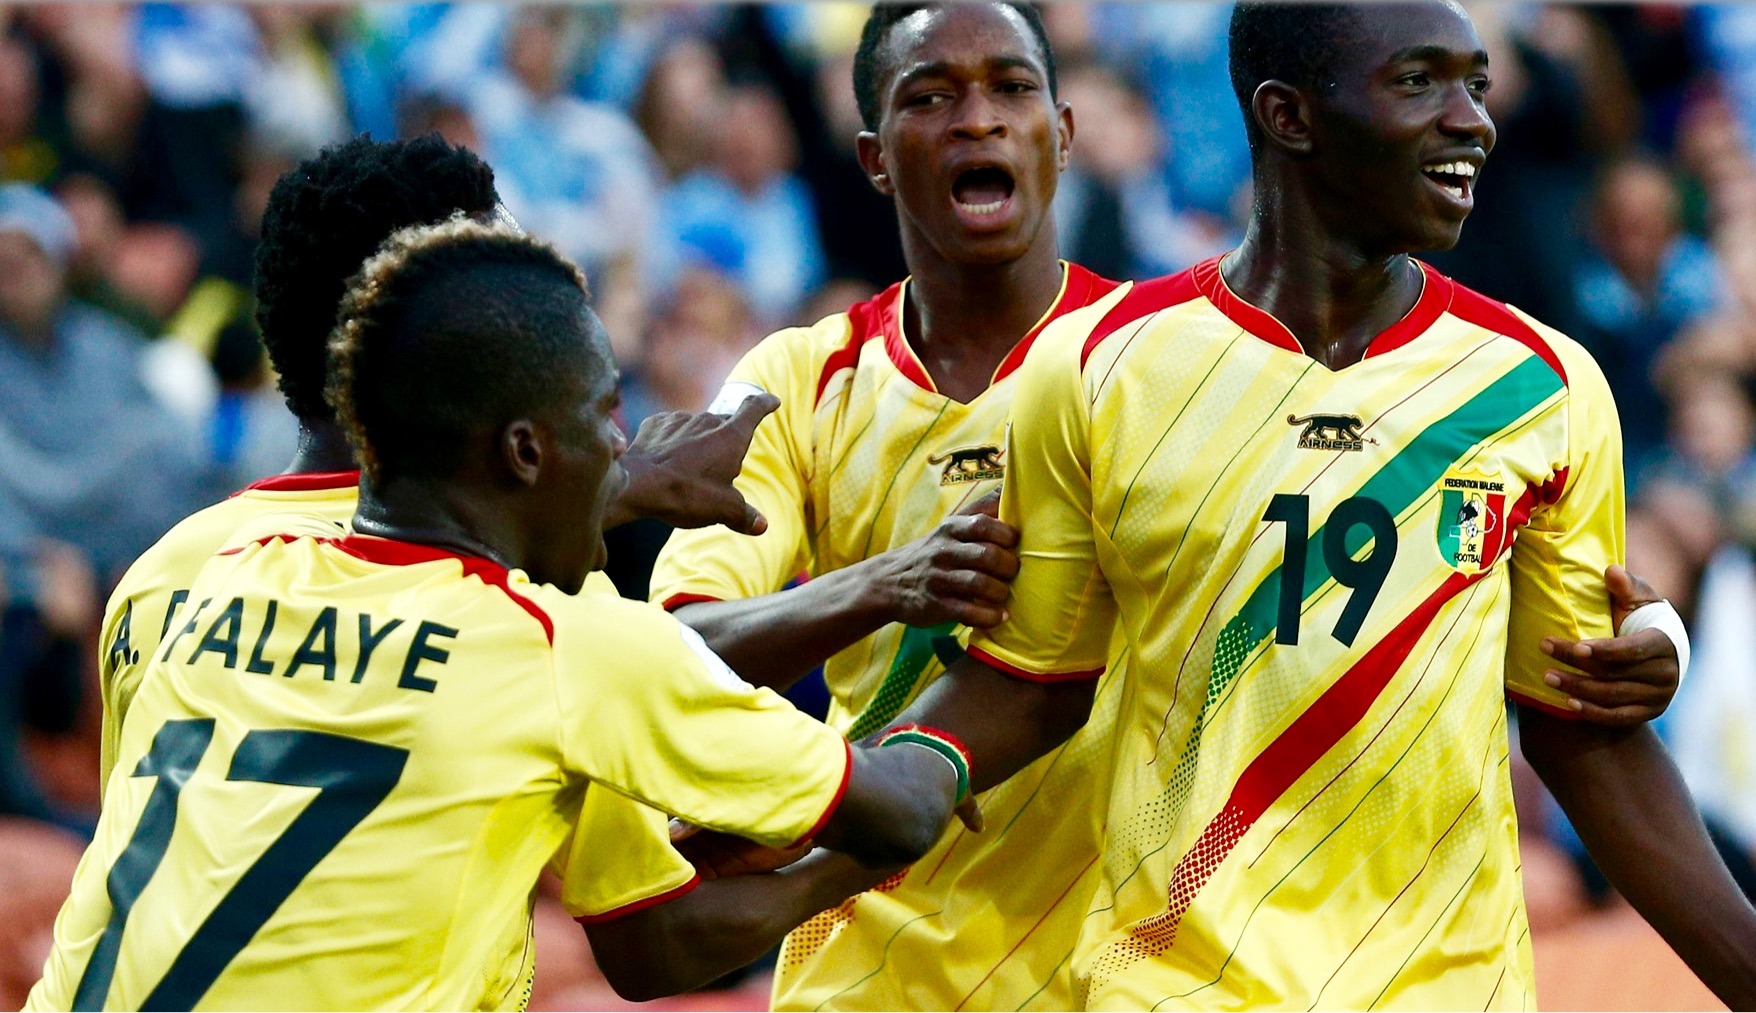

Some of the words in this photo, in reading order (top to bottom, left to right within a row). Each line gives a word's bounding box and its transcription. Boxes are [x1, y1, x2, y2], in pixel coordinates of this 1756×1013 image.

[1261, 493, 1398, 648] 19
[1467, 543, 1477, 552] DE
[161, 597, 459, 693] FALAYE
[71, 717, 410, 1013] 17
